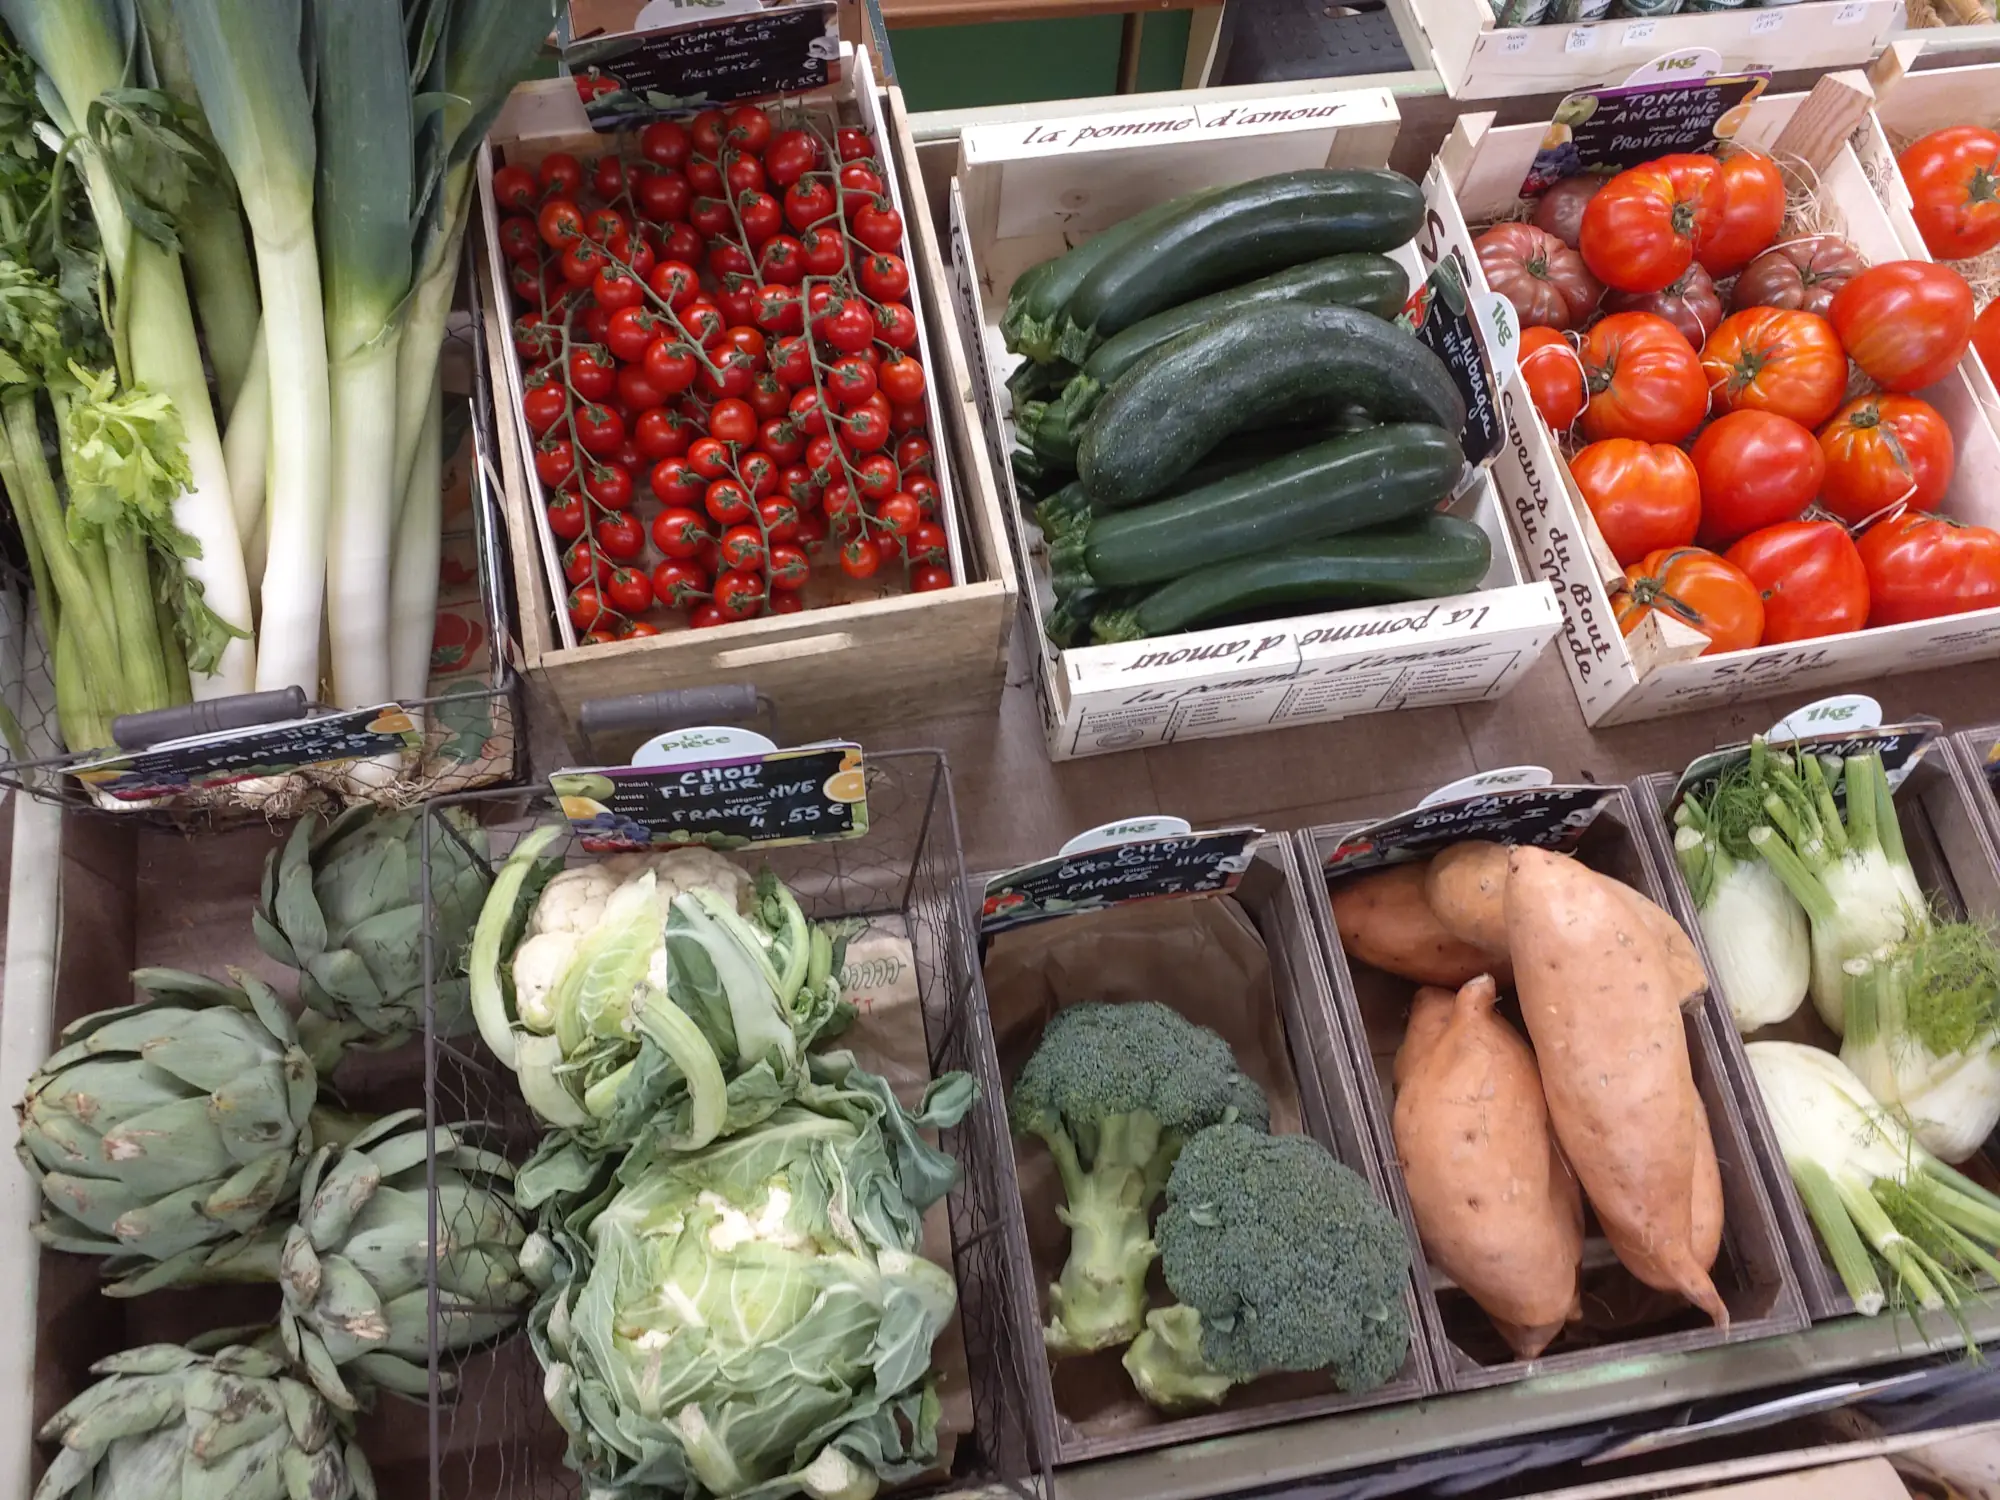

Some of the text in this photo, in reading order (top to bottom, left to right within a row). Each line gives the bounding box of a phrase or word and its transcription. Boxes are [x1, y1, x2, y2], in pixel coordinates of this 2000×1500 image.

[672, 26, 737, 45] TOMATE
[1625, 88, 1722, 108] TOMATE
[1022, 104, 1347, 148] la pomme d'amour
[1680, 115, 1715, 130] HVE
[1610, 130, 1700, 151] PROVENCE
[1491, 301, 1513, 348] 1kg
[1443, 331, 1464, 368] HVE
[1460, 336, 1491, 440] Aubergine
[1516, 495, 1538, 544] du
[1550, 527, 1569, 572] du
[1571, 583, 1611, 663] Bout
[1121, 605, 1490, 672] la pomme d'amour
[1806, 705, 1861, 721] 1kg
[683, 733, 703, 742] La
[680, 764, 763, 785] CHOU
[768, 779, 816, 798] HVE
[672, 801, 772, 823] FRANCE
[1464, 790, 1575, 812] PATATE
[1413, 808, 1502, 829] DOUCE
[1066, 870, 1152, 895] FRANCE
